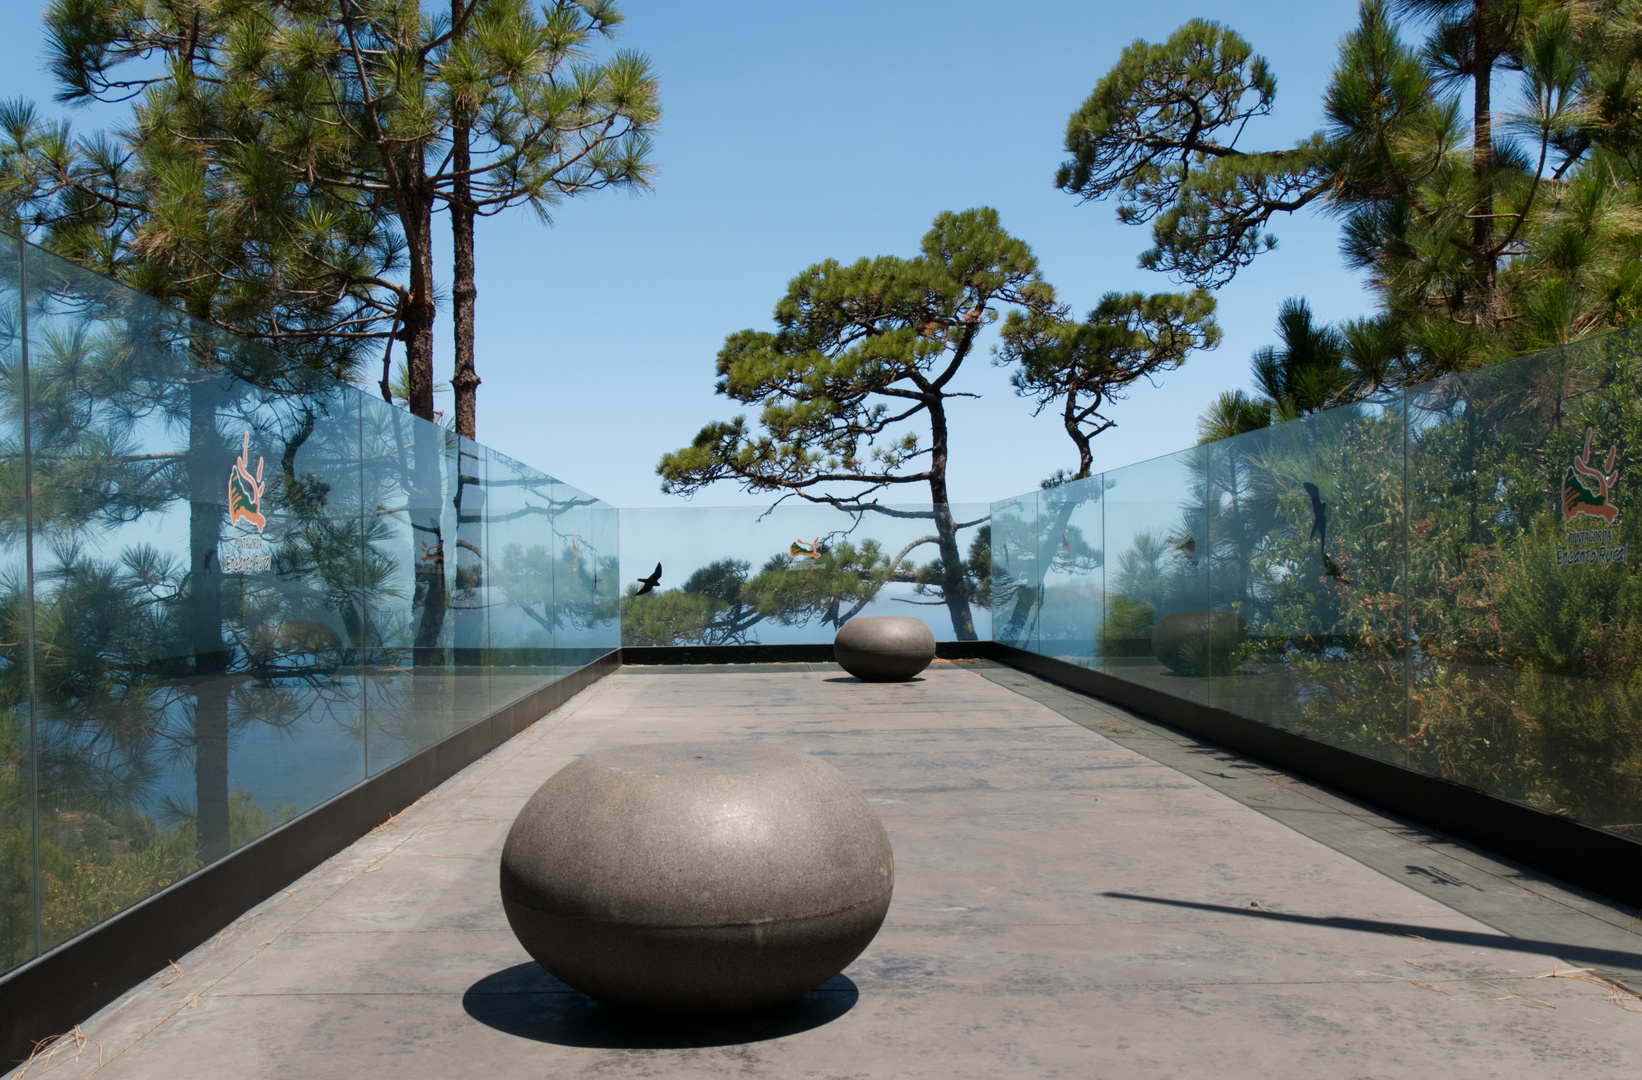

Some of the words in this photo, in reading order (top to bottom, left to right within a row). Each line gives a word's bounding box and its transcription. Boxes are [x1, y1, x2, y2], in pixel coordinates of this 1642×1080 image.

[1568, 529, 1612, 544] PUNTAGORDA
[1556, 547, 1597, 565] Encanto
[1599, 543, 1628, 563] Rural
